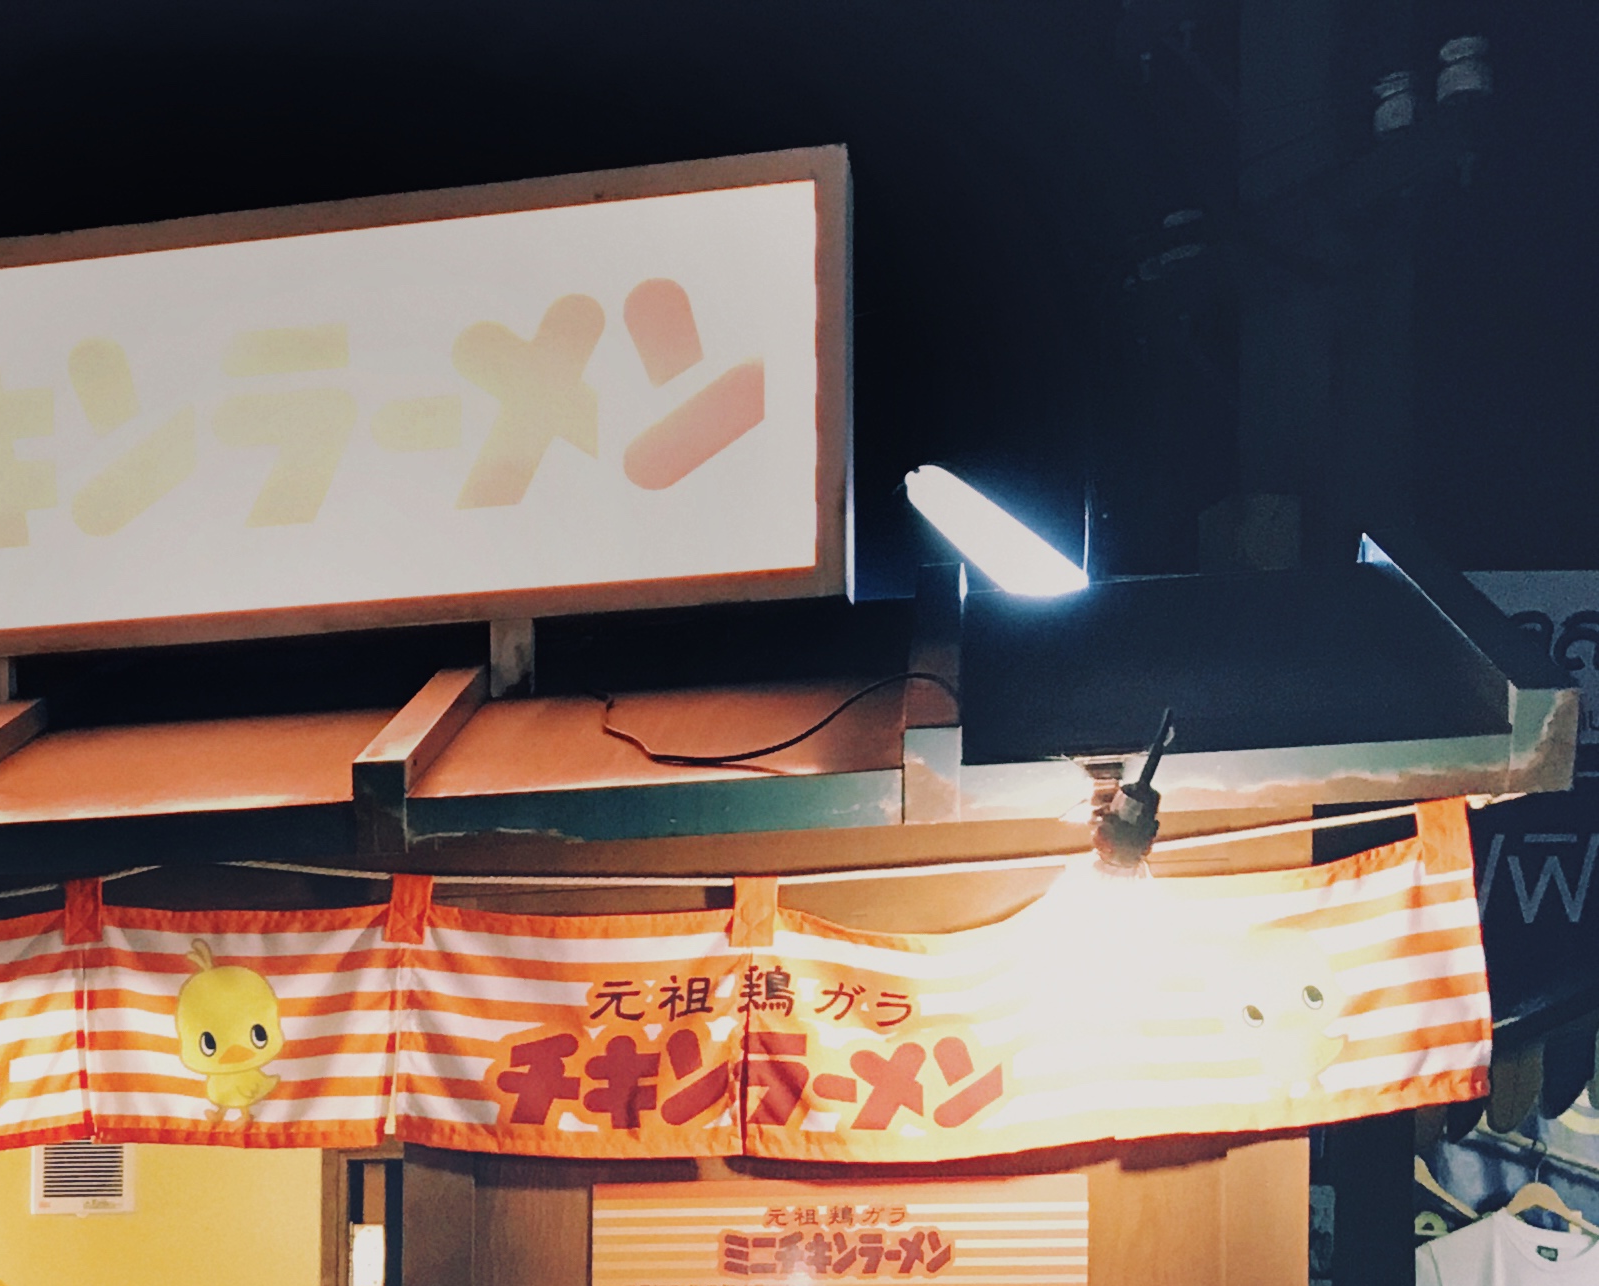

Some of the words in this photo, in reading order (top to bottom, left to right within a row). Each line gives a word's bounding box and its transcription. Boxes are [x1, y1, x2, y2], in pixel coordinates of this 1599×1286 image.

[589, 965, 914, 1027] 元祖鶏ガラ
[497, 1029, 1004, 1131] チキンラーメン
[765, 1206, 907, 1227] 元祖鶏ガラ
[723, 1230, 953, 1275] ミニチキンラーメン
